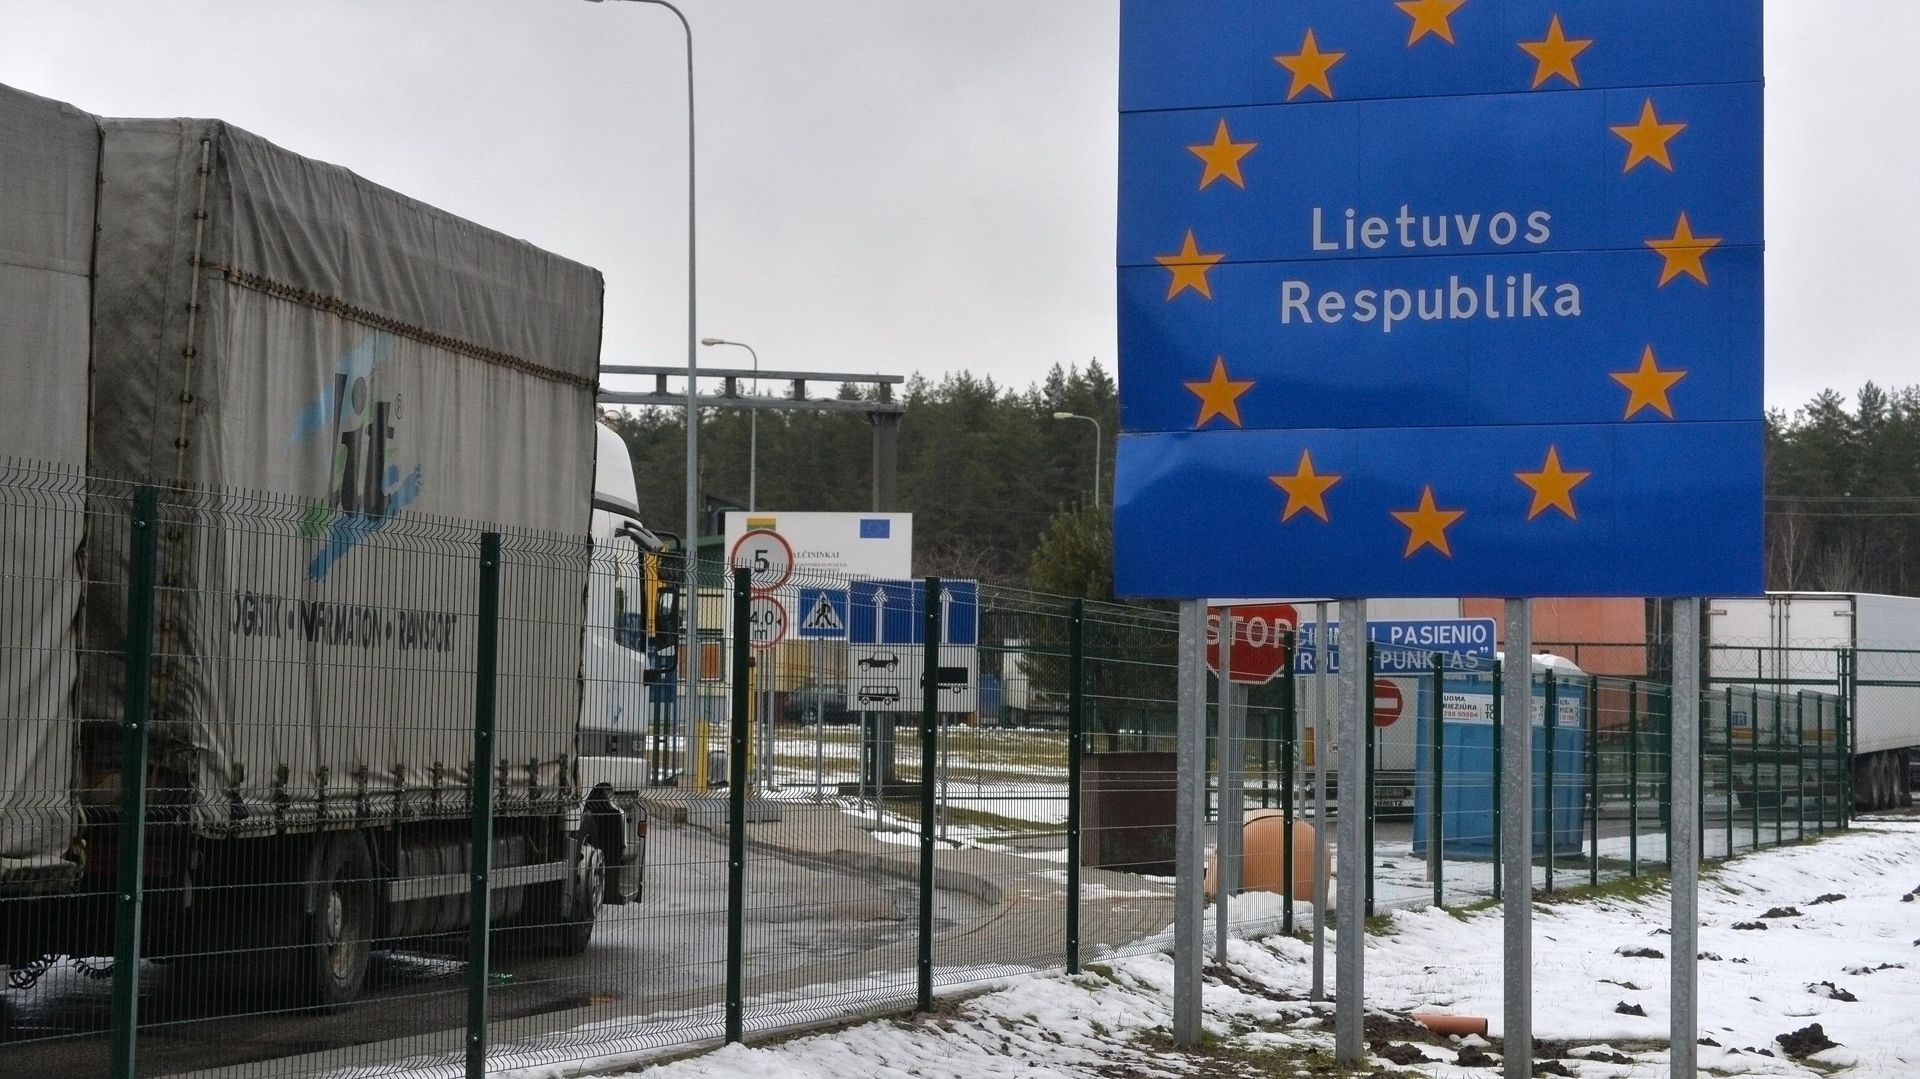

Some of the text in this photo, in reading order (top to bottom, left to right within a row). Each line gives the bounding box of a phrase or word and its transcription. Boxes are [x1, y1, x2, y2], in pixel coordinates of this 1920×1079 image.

[1312, 204, 1552, 250] Lietuvos
[1281, 273, 1581, 332] Respublika
[754, 549, 769, 573] 5
[397, 609, 458, 653] RANSPORT
[754, 629, 768, 640] m
[1206, 614, 1293, 648] STOP
[1391, 625, 1487, 645] PASIENIO
